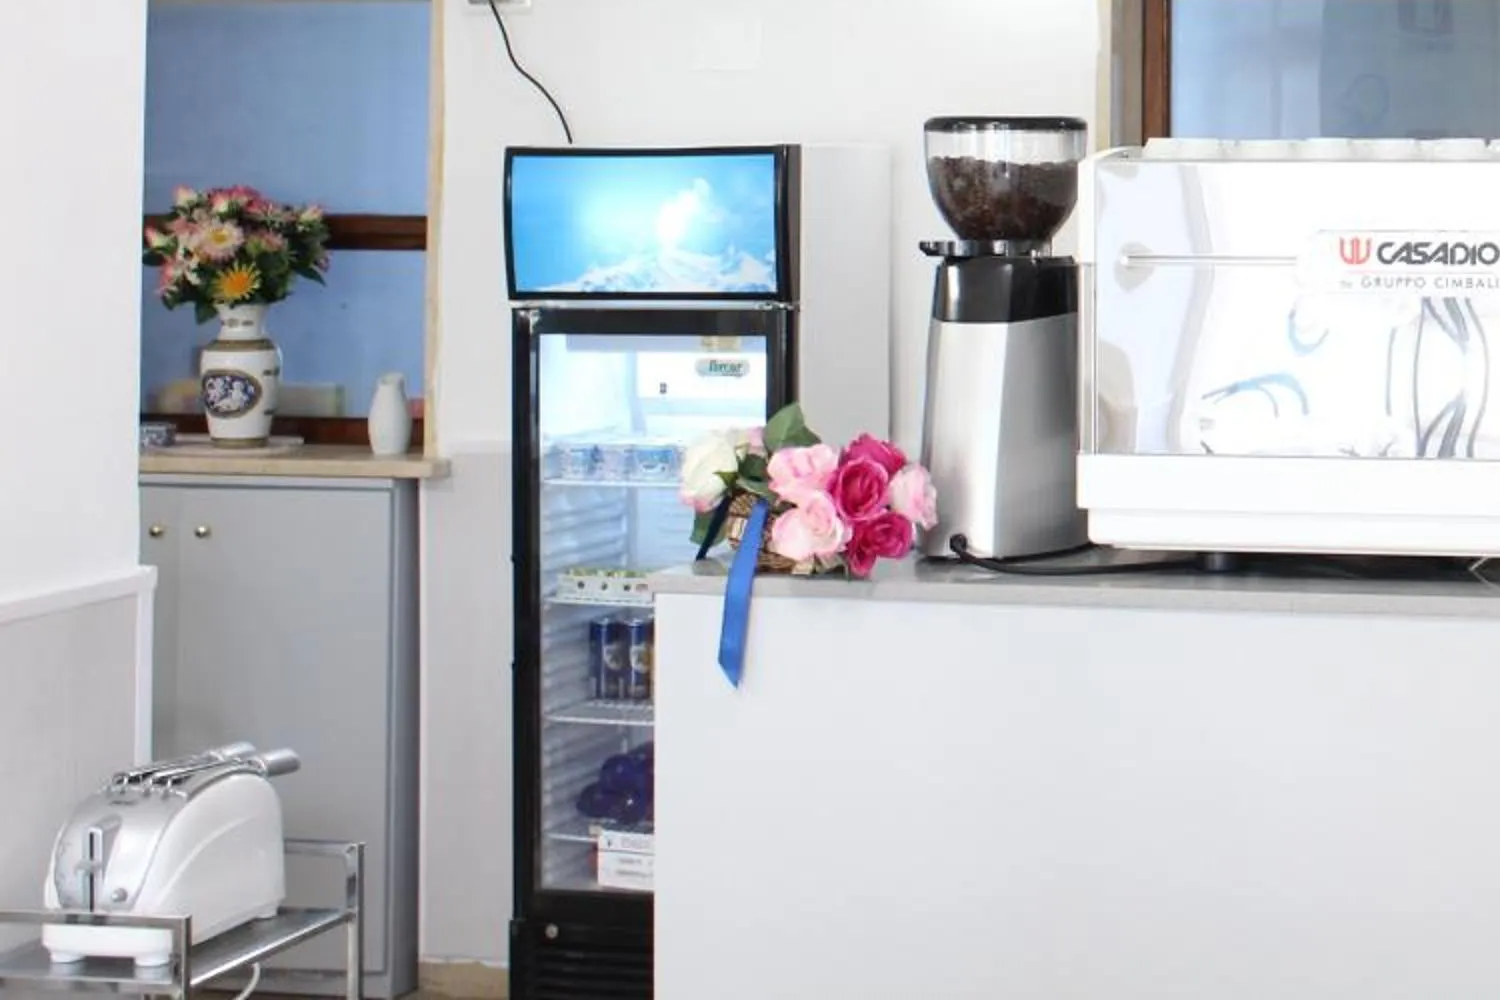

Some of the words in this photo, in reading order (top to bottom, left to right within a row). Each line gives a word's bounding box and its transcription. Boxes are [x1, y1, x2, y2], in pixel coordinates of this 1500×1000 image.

[1377, 241, 1500, 266] CASADIO
[1360, 276, 1427, 289] GRUPPO
[1433, 276, 1500, 289] CIMBALI
